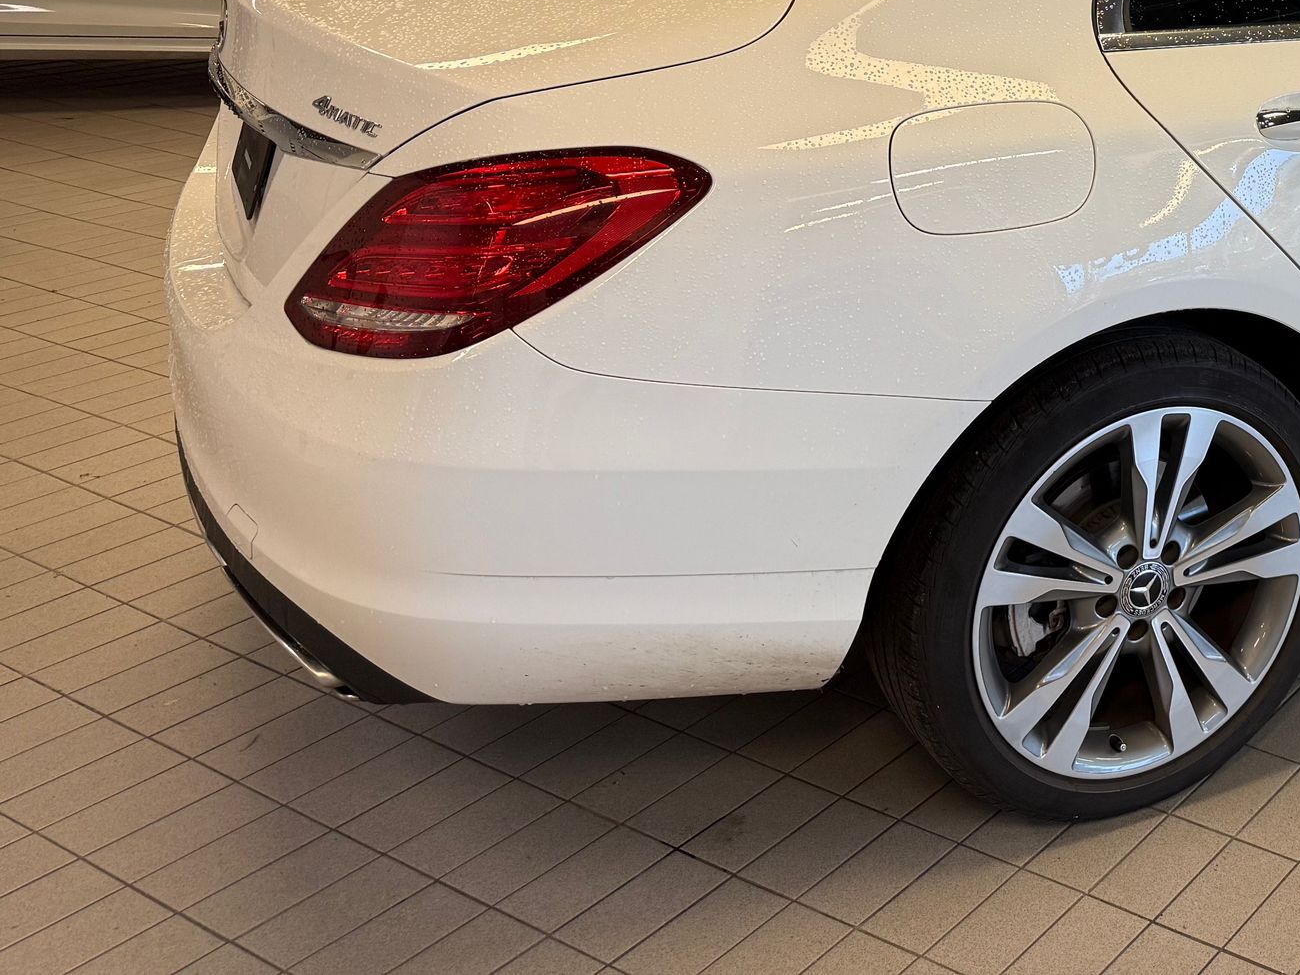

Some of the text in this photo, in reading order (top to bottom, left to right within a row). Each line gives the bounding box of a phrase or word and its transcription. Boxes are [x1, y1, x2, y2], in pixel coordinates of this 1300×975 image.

[312, 95, 383, 138] 4MATIC
[1132, 564, 1149, 577] BENZ
[1134, 594, 1165, 616] MERCEDES
